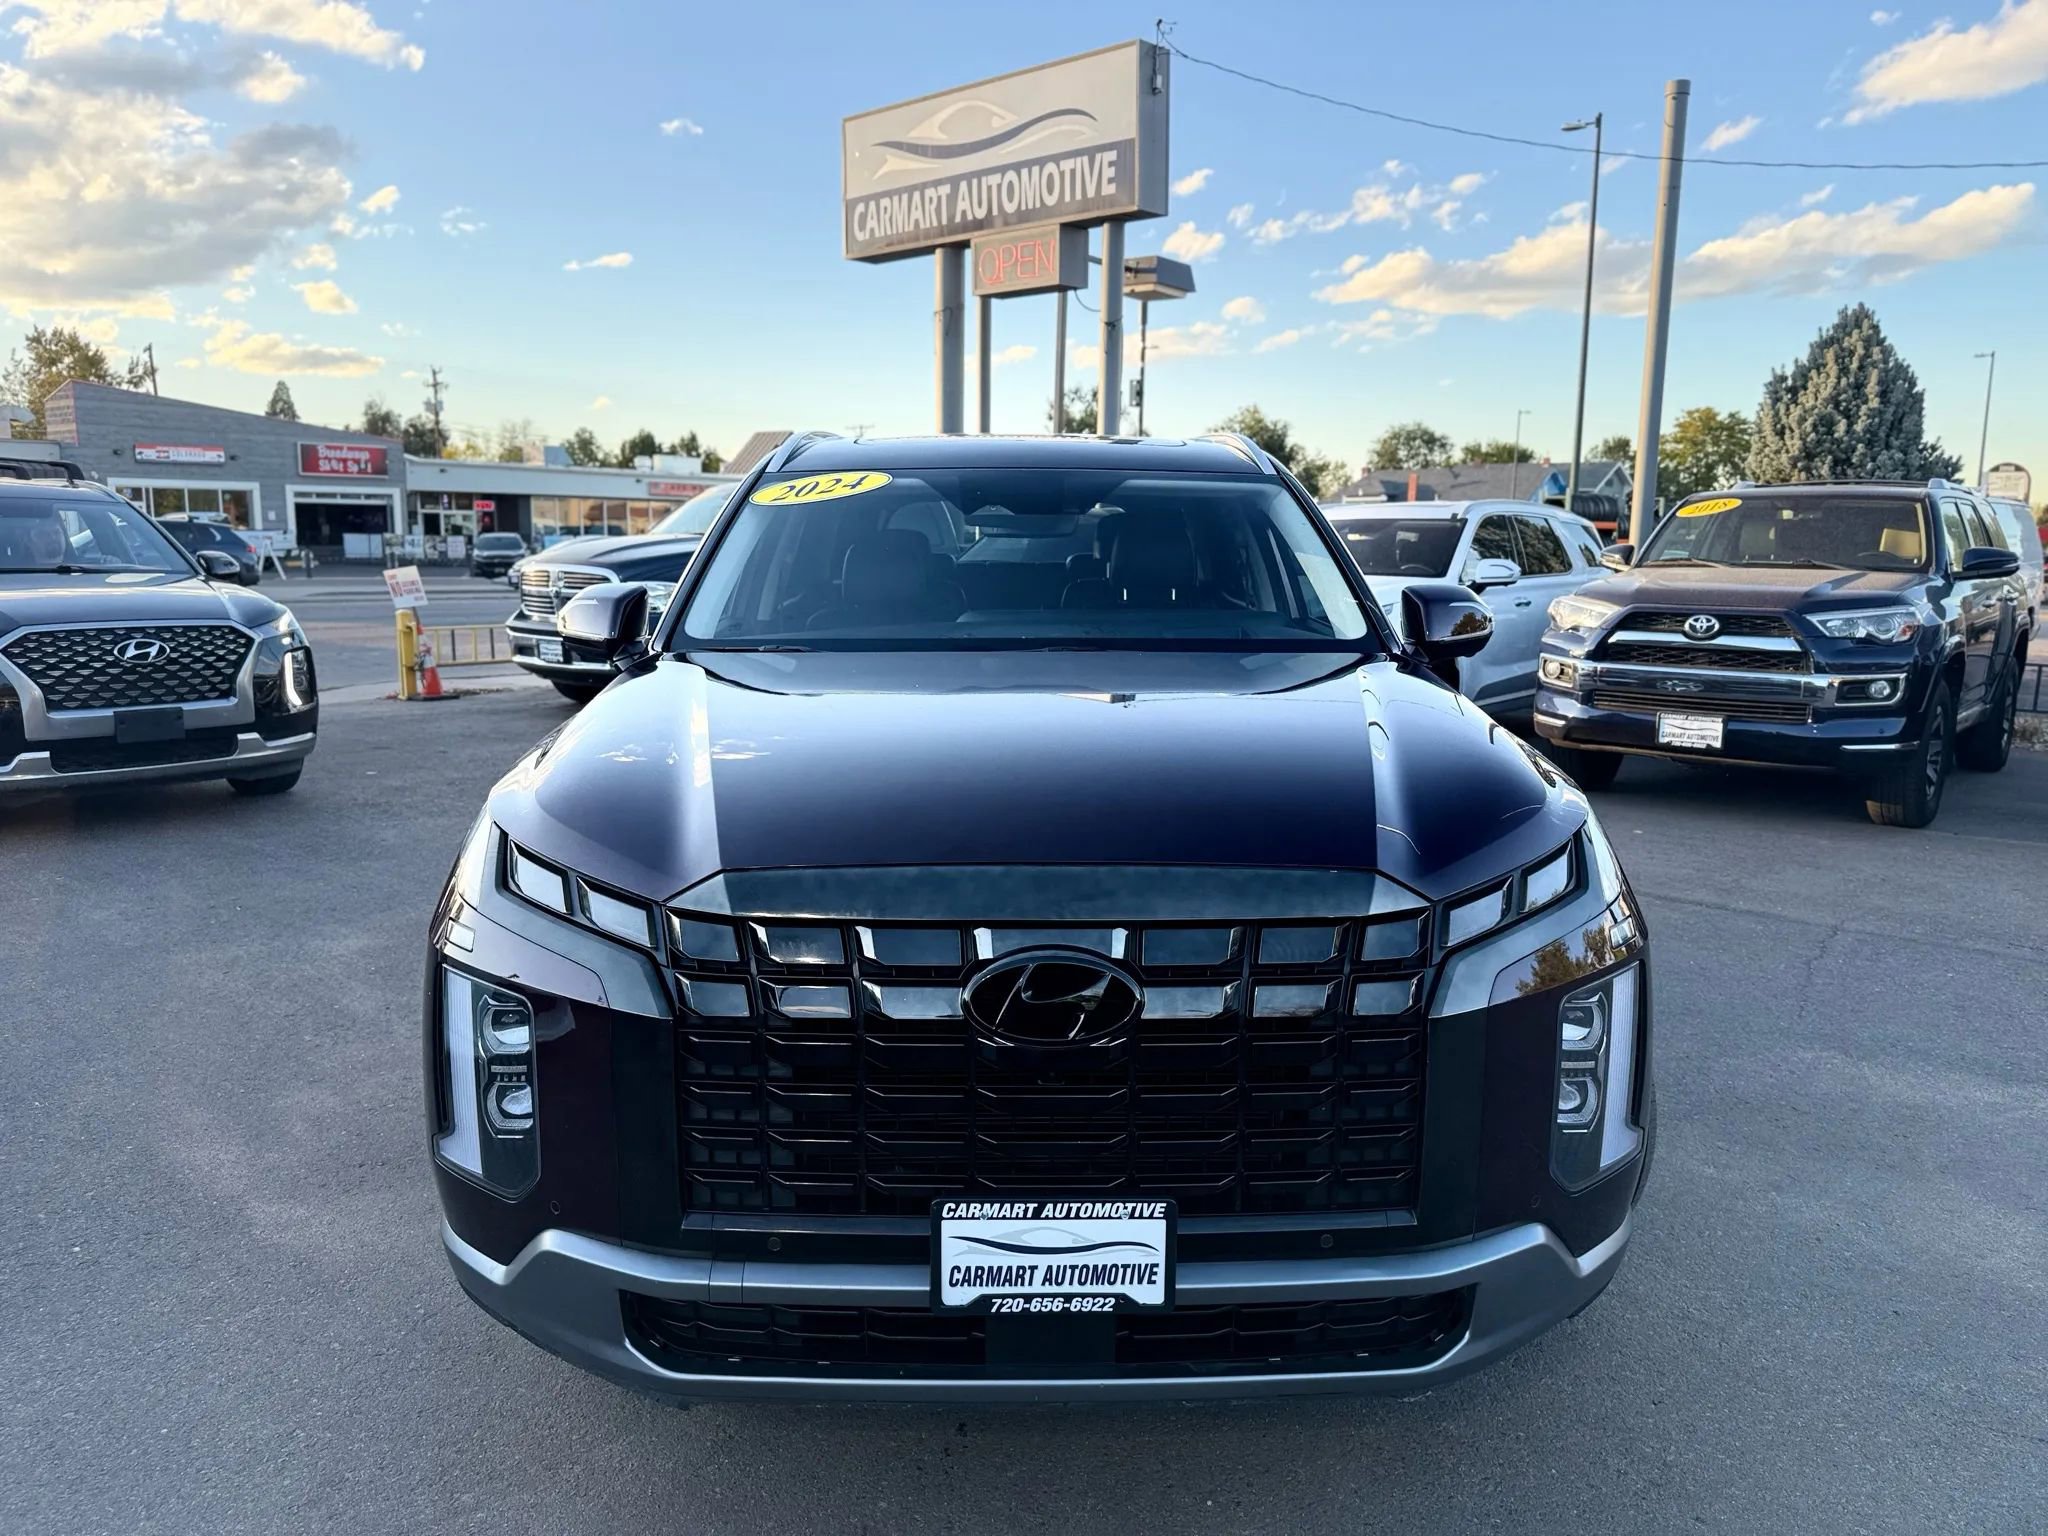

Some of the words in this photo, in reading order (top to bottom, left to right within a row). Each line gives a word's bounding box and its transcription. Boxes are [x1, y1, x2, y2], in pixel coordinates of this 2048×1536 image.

[854, 184, 950, 241] CARMART
[955, 150, 1117, 223] AUTOMOTIVE
[979, 239, 1056, 285] OPEN
[769, 474, 870, 502] 2024
[1688, 500, 1732, 515] 2018
[1662, 730, 1686, 739] CARMART
[1686, 733, 1720, 743] AUTOMOTIVE
[942, 1202, 1038, 1219] CARMART
[1040, 1202, 1167, 1218] AUTOMOTIVE
[948, 1264, 1038, 1288] CARMART
[1041, 1263, 1160, 1287] AUTOMOTIVE
[990, 1297, 1116, 1313] 720-656-6922
